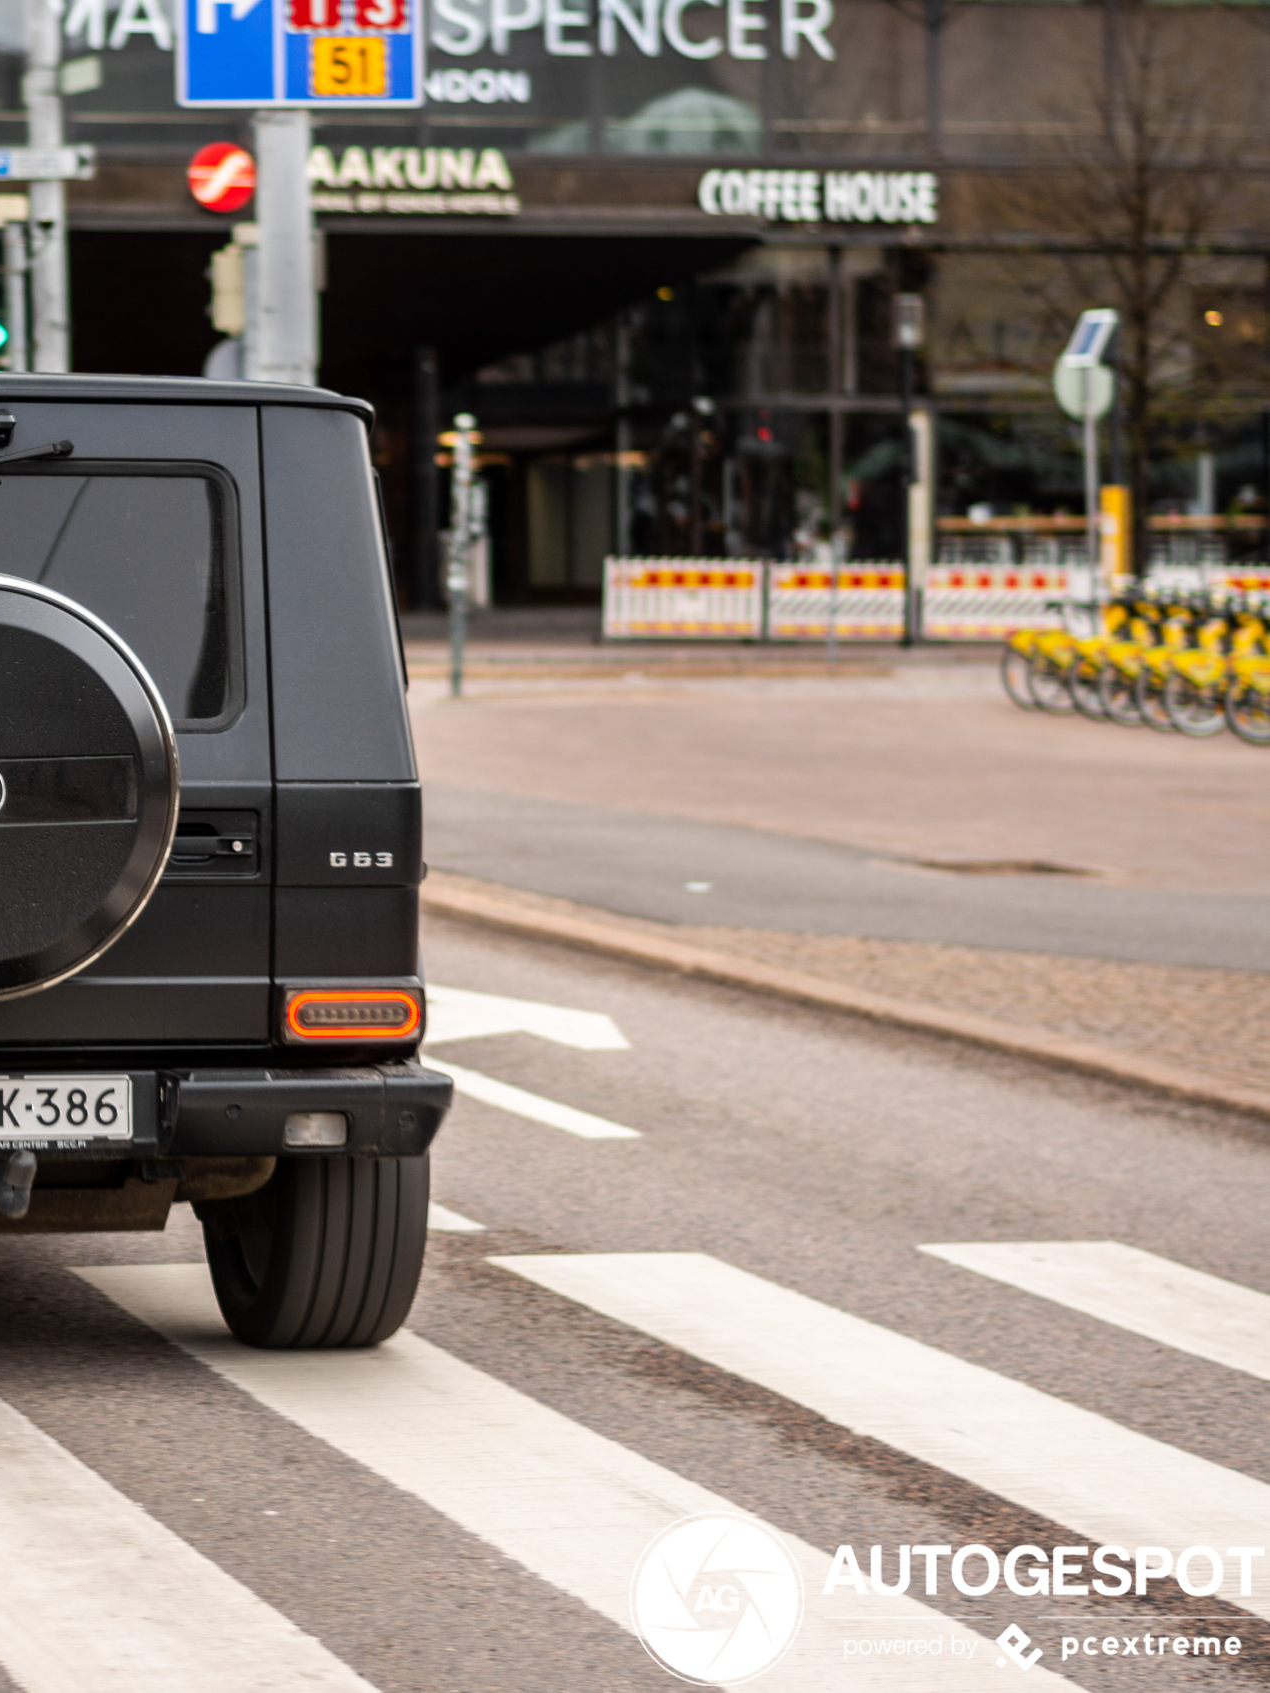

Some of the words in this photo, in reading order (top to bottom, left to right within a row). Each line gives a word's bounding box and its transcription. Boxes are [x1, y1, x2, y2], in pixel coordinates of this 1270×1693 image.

[430, 0, 837, 60] SPENCER
[331, 46, 369, 84] 51
[307, 145, 515, 190] AAKUNA
[697, 168, 822, 223] COFFEE
[824, 171, 938, 223] HOUSE
[12, 1139, 49, 1149] CENTER
